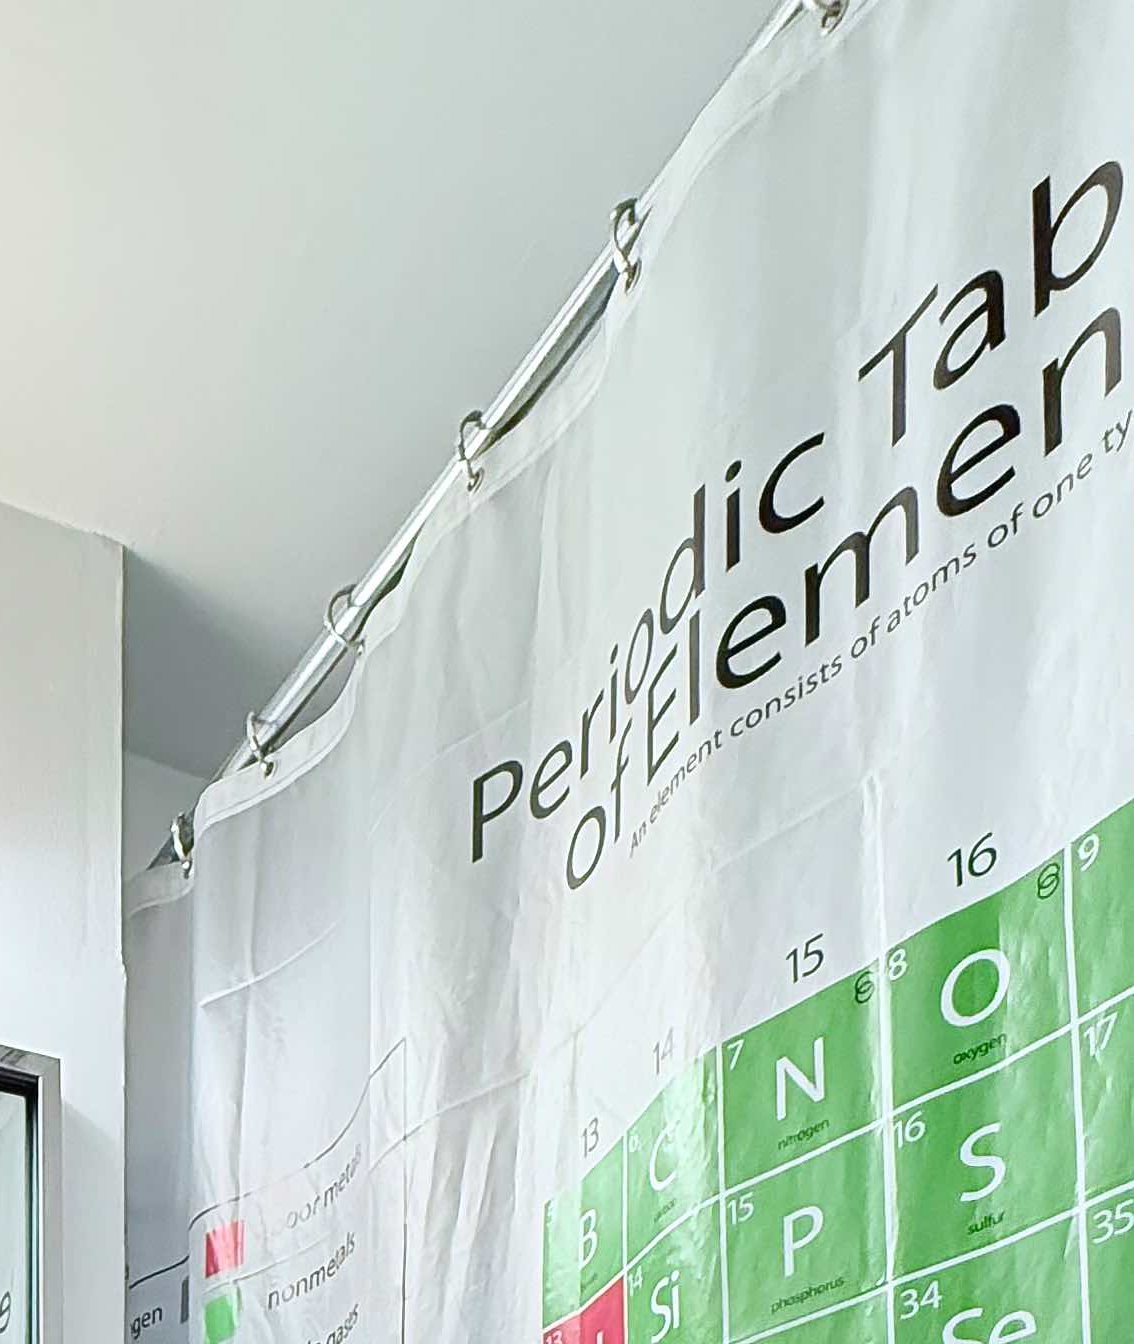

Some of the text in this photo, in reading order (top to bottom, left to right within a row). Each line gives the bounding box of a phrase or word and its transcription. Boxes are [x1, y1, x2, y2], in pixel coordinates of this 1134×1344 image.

[472, 160, 1124, 863] Periodic Tab
[566, 307, 1122, 890] of Elemen
[649, 729, 723, 824] element
[730, 654, 843, 738] consists
[851, 617, 880, 659] of
[886, 544, 977, 635] atoms
[987, 504, 1025, 549] of
[1032, 452, 1093, 518] one
[947, 832, 997, 887] 16
[1078, 832, 1099, 872] 9
[786, 933, 824, 984] 15
[888, 948, 908, 982] 8
[941, 949, 1011, 1027] O
[653, 1028, 673, 1075] 14
[727, 1039, 745, 1071] 7
[953, 1031, 1008, 1066] oxygen
[776, 1036, 825, 1121] N
[582, 1117, 599, 1158] 13
[778, 1118, 830, 1151] nitrogen
[891, 1110, 926, 1148] 16
[959, 1120, 1007, 1202] S
[727, 1192, 754, 1225] 15
[966, 1209, 1006, 1236] sulfur
[1092, 1198, 1134, 1244] 35
[577, 1208, 598, 1269] B
[782, 1205, 824, 1278] P
[268, 1231, 355, 1310] nonmetals
[627, 1266, 643, 1296] 14
[650, 1269, 681, 1344] Si
[770, 1276, 845, 1315] phosphorus
[900, 1280, 943, 1320] 34
[131, 1305, 163, 1339] gen
